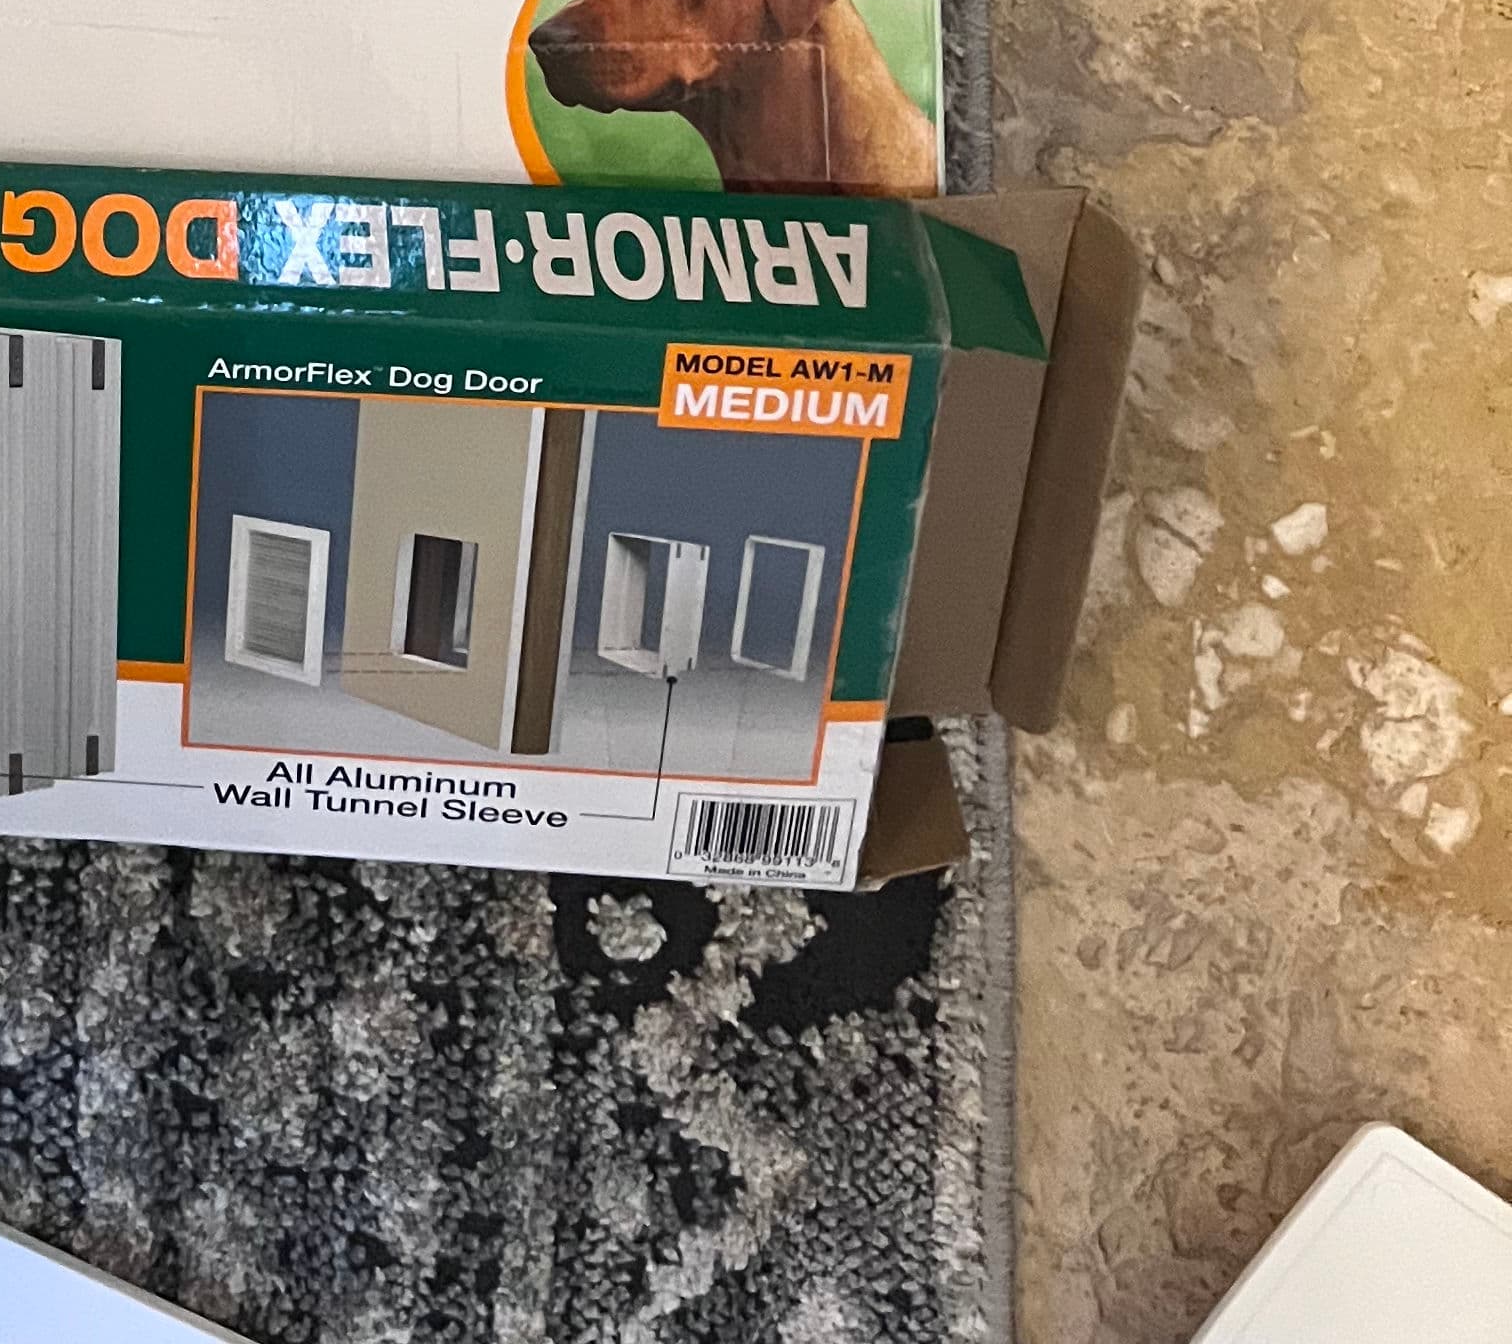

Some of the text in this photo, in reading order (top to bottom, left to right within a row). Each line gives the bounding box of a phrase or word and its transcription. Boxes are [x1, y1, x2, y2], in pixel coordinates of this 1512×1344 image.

[0, 190, 240, 280] DOG
[207, 358, 542, 394] ArmorFlex Dog Door
[675, 353, 894, 384] MODEL AW1-M
[674, 384, 889, 427] MEDIUM
[267, 761, 517, 798] All Aluminum
[214, 783, 568, 828] Wall Tunnel Sleeve
